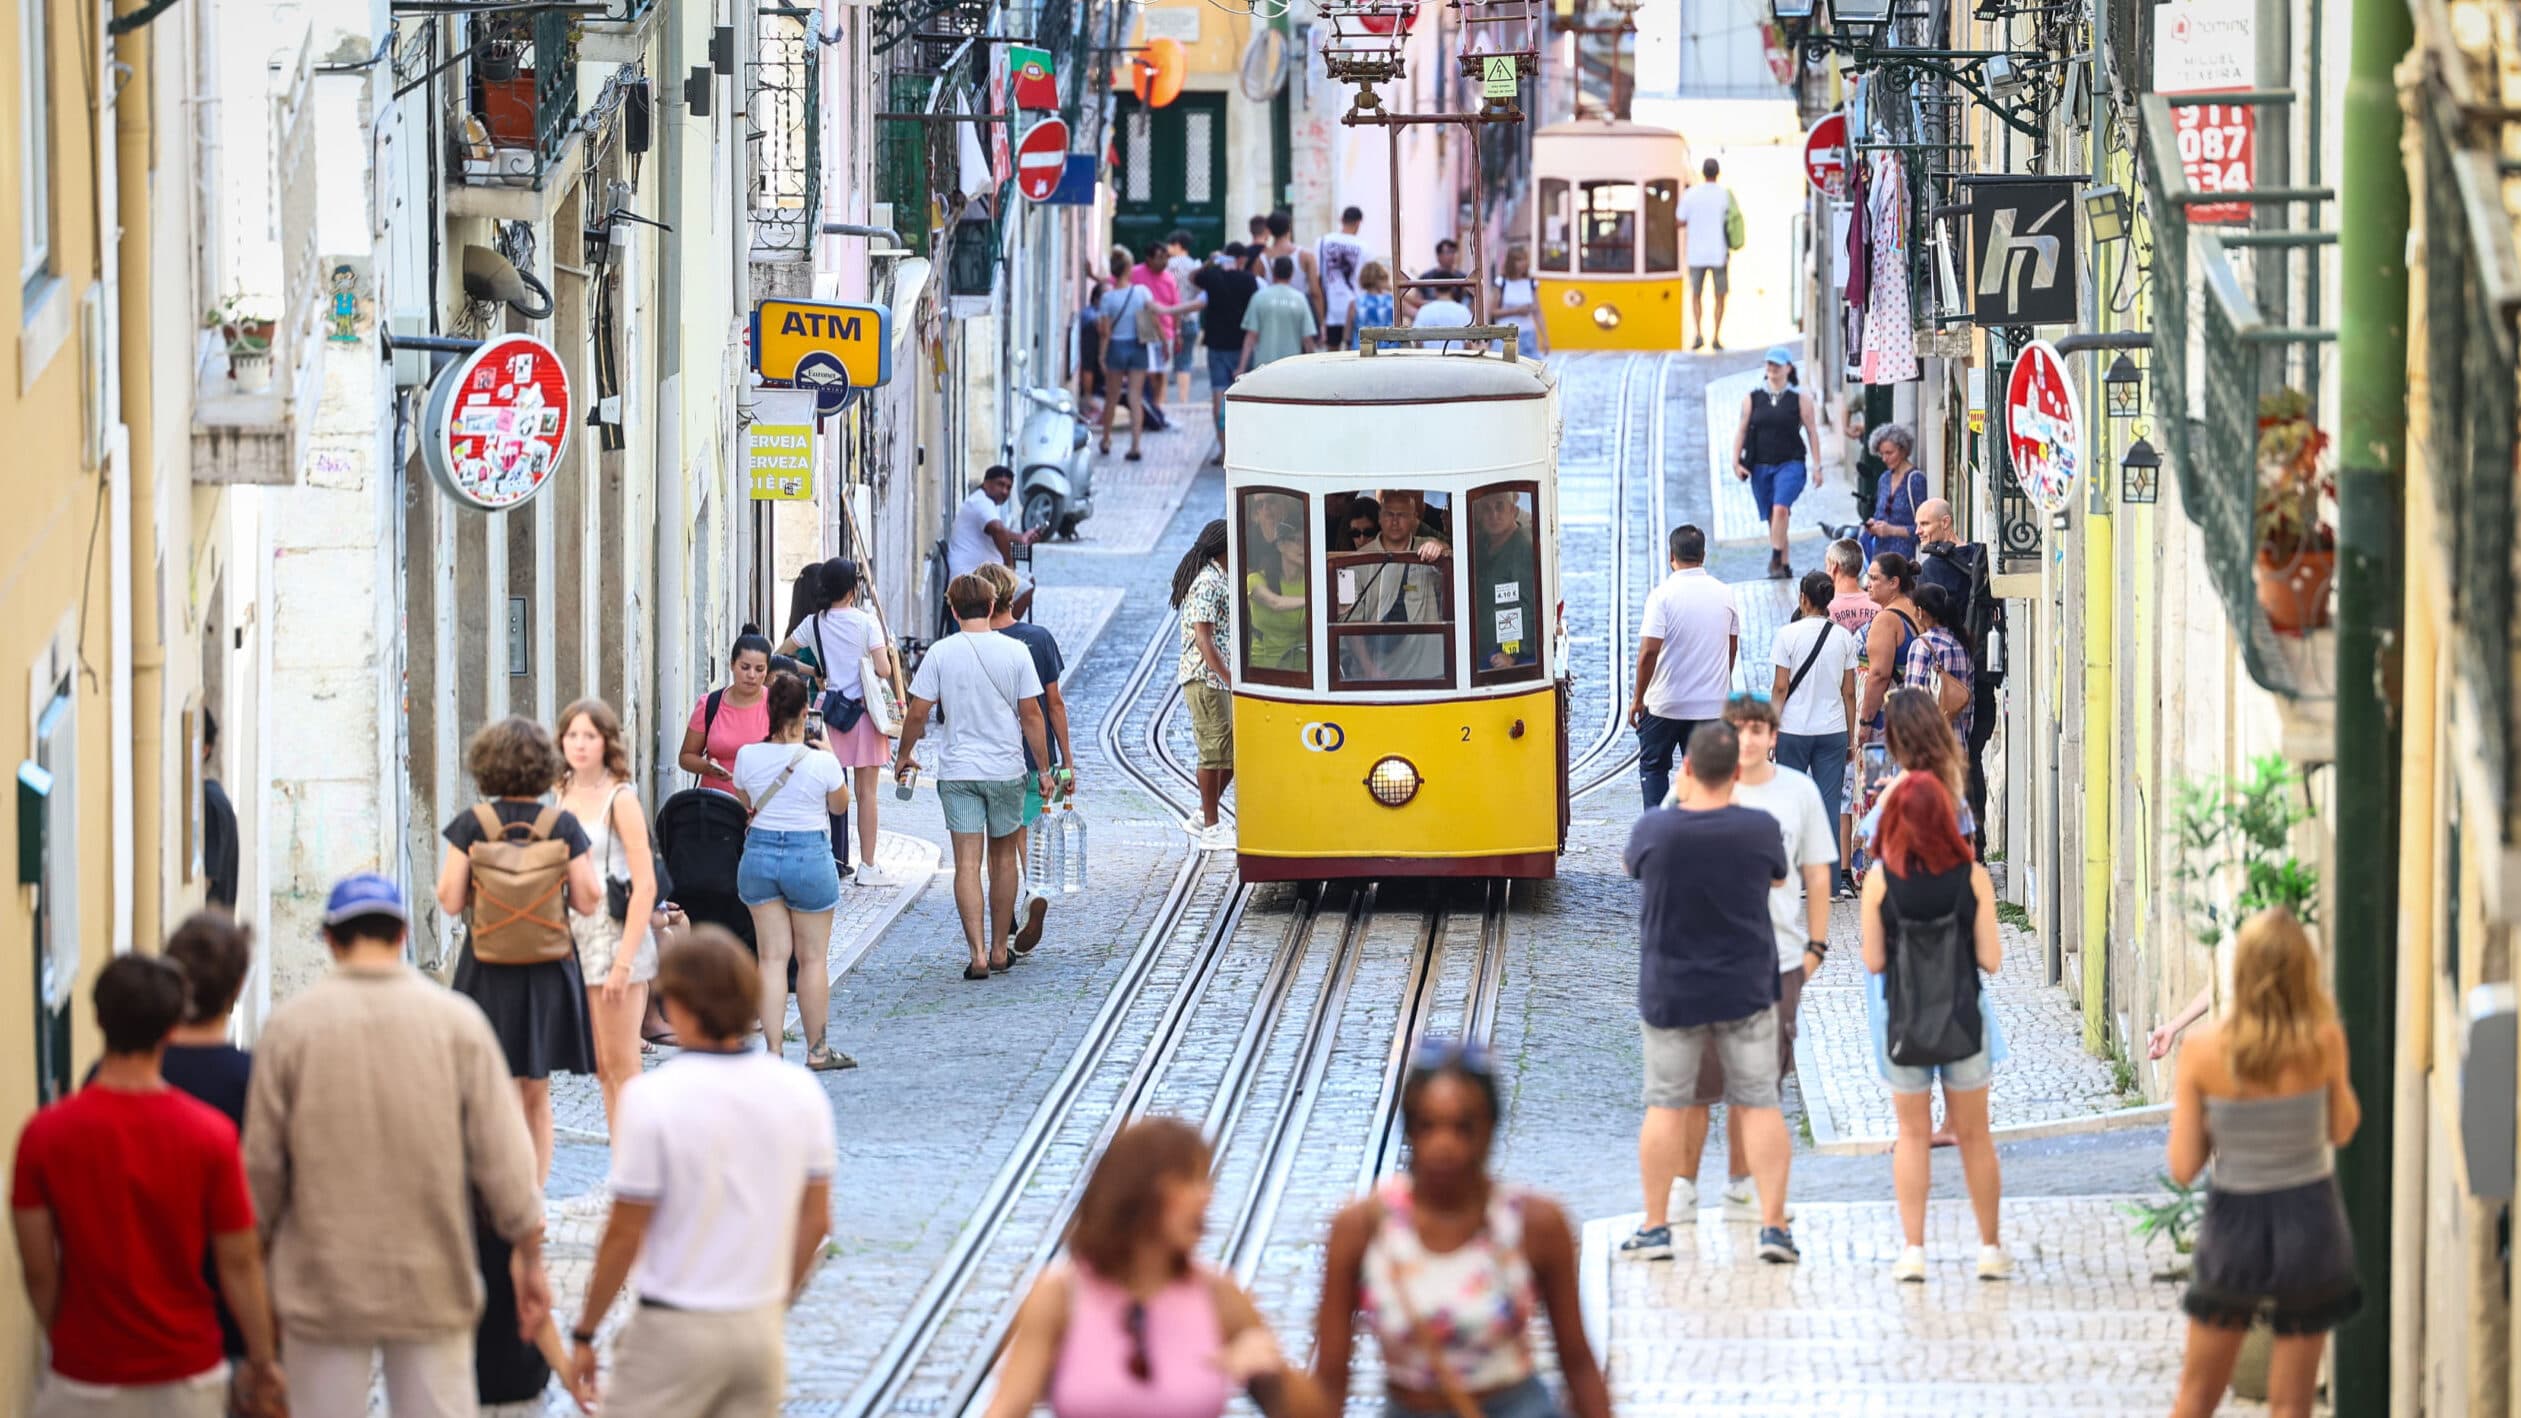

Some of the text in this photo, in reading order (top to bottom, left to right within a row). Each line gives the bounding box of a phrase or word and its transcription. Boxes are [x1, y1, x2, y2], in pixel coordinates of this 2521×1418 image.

[2177, 126, 2248, 161] 087
[781, 311, 862, 342] ATM
[808, 369, 836, 379] Euronet
[751, 434, 808, 449] ERVEJA
[750, 455, 809, 469] ERVEZA
[750, 473, 804, 490] IÈRE
[1834, 609, 1857, 622] BORN
[1461, 725, 1471, 742] 2
